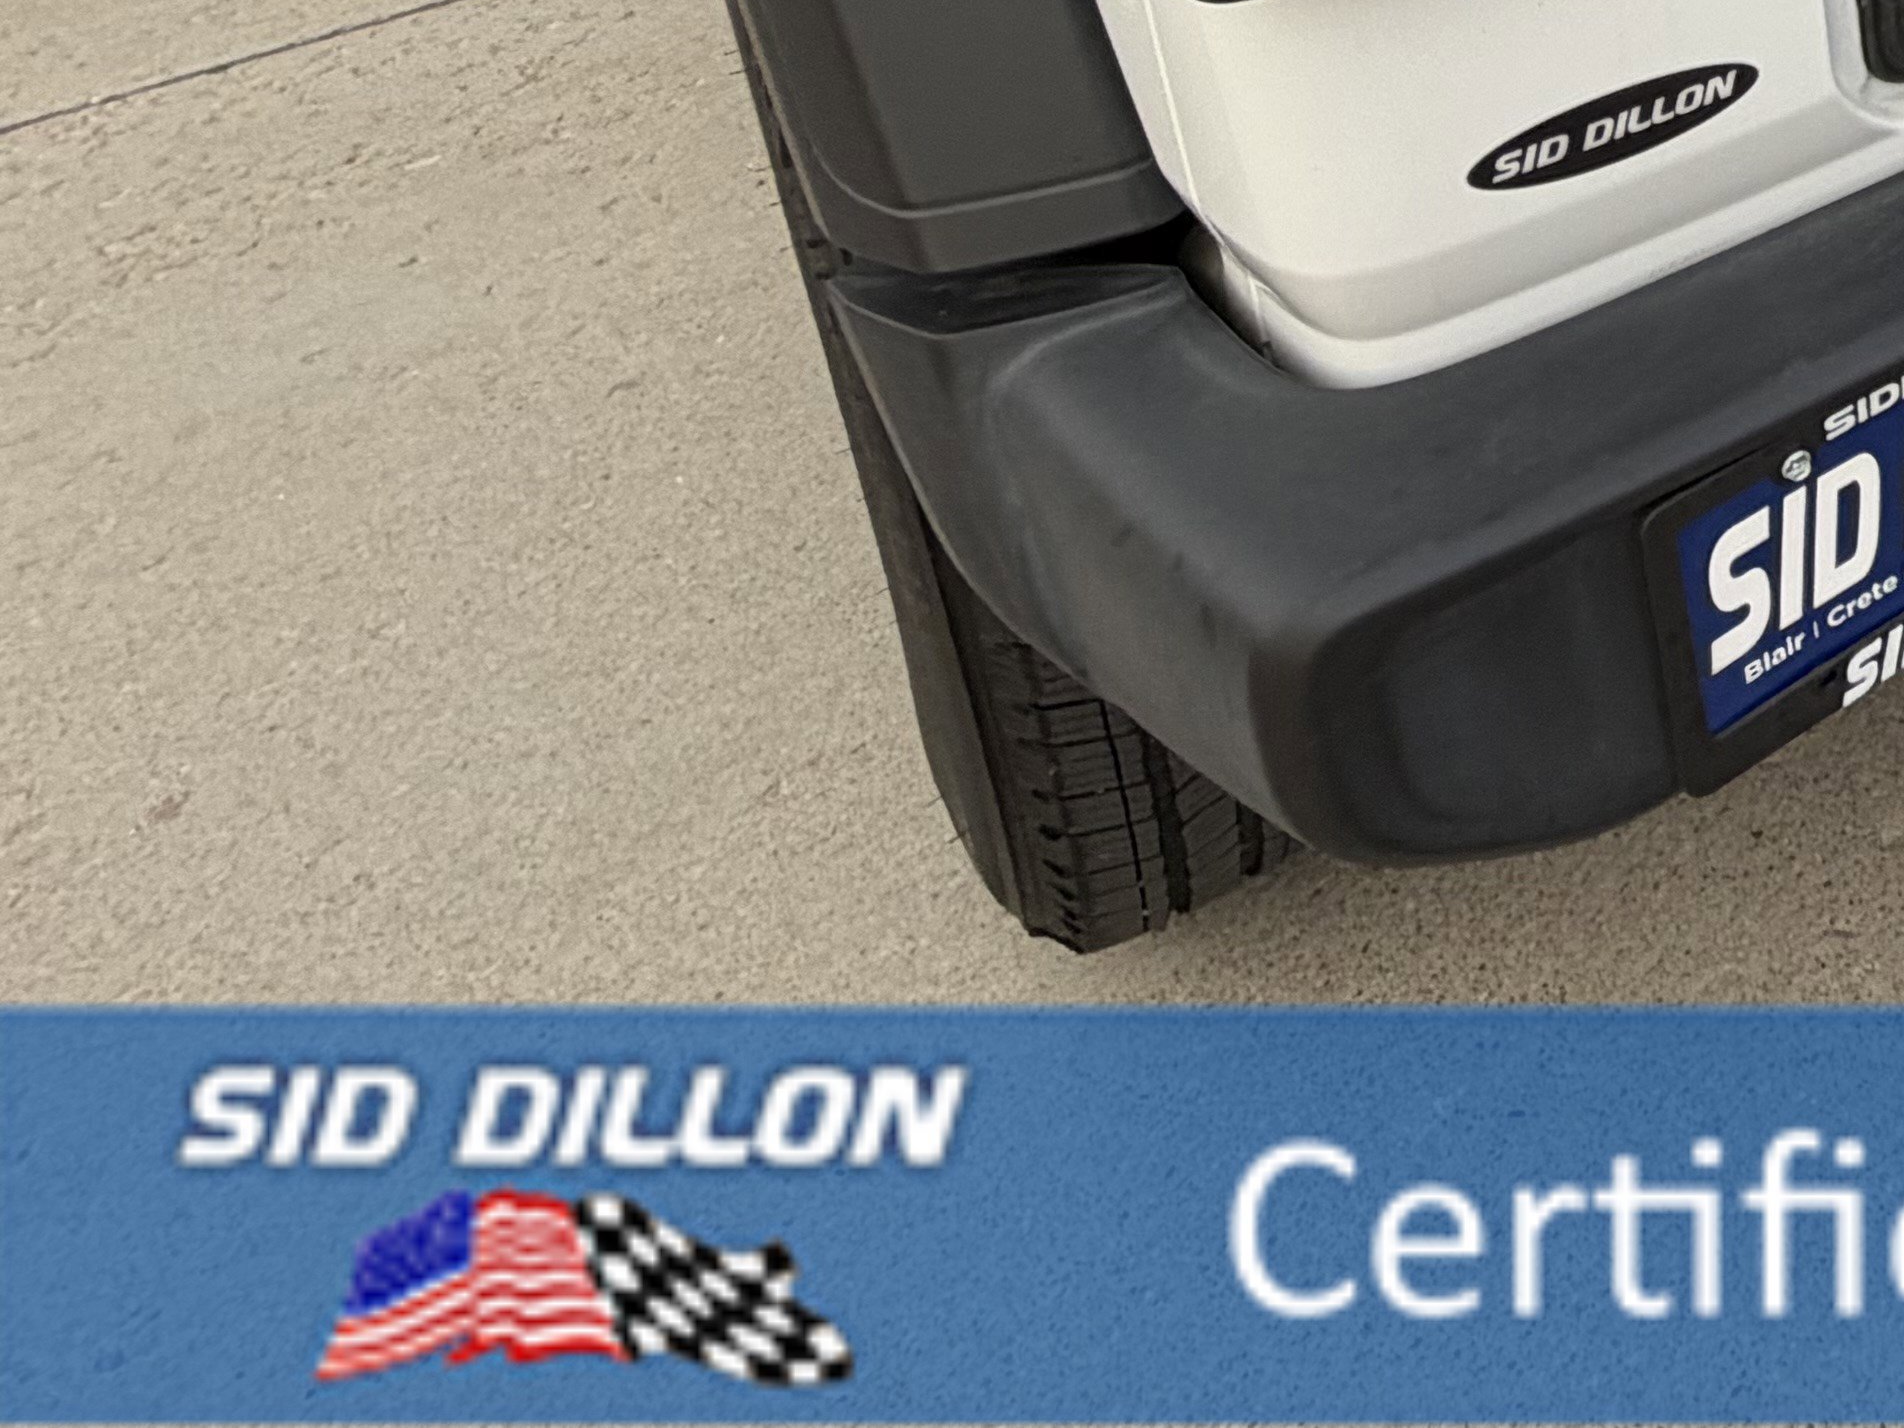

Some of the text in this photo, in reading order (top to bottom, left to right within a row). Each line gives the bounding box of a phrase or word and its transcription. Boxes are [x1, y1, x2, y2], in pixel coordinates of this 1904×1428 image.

[1492, 69, 1738, 185] SID DILLON
[1707, 452, 1882, 677] SID
[1744, 630, 1804, 685] Blair
[1826, 572, 1899, 629] Crete
